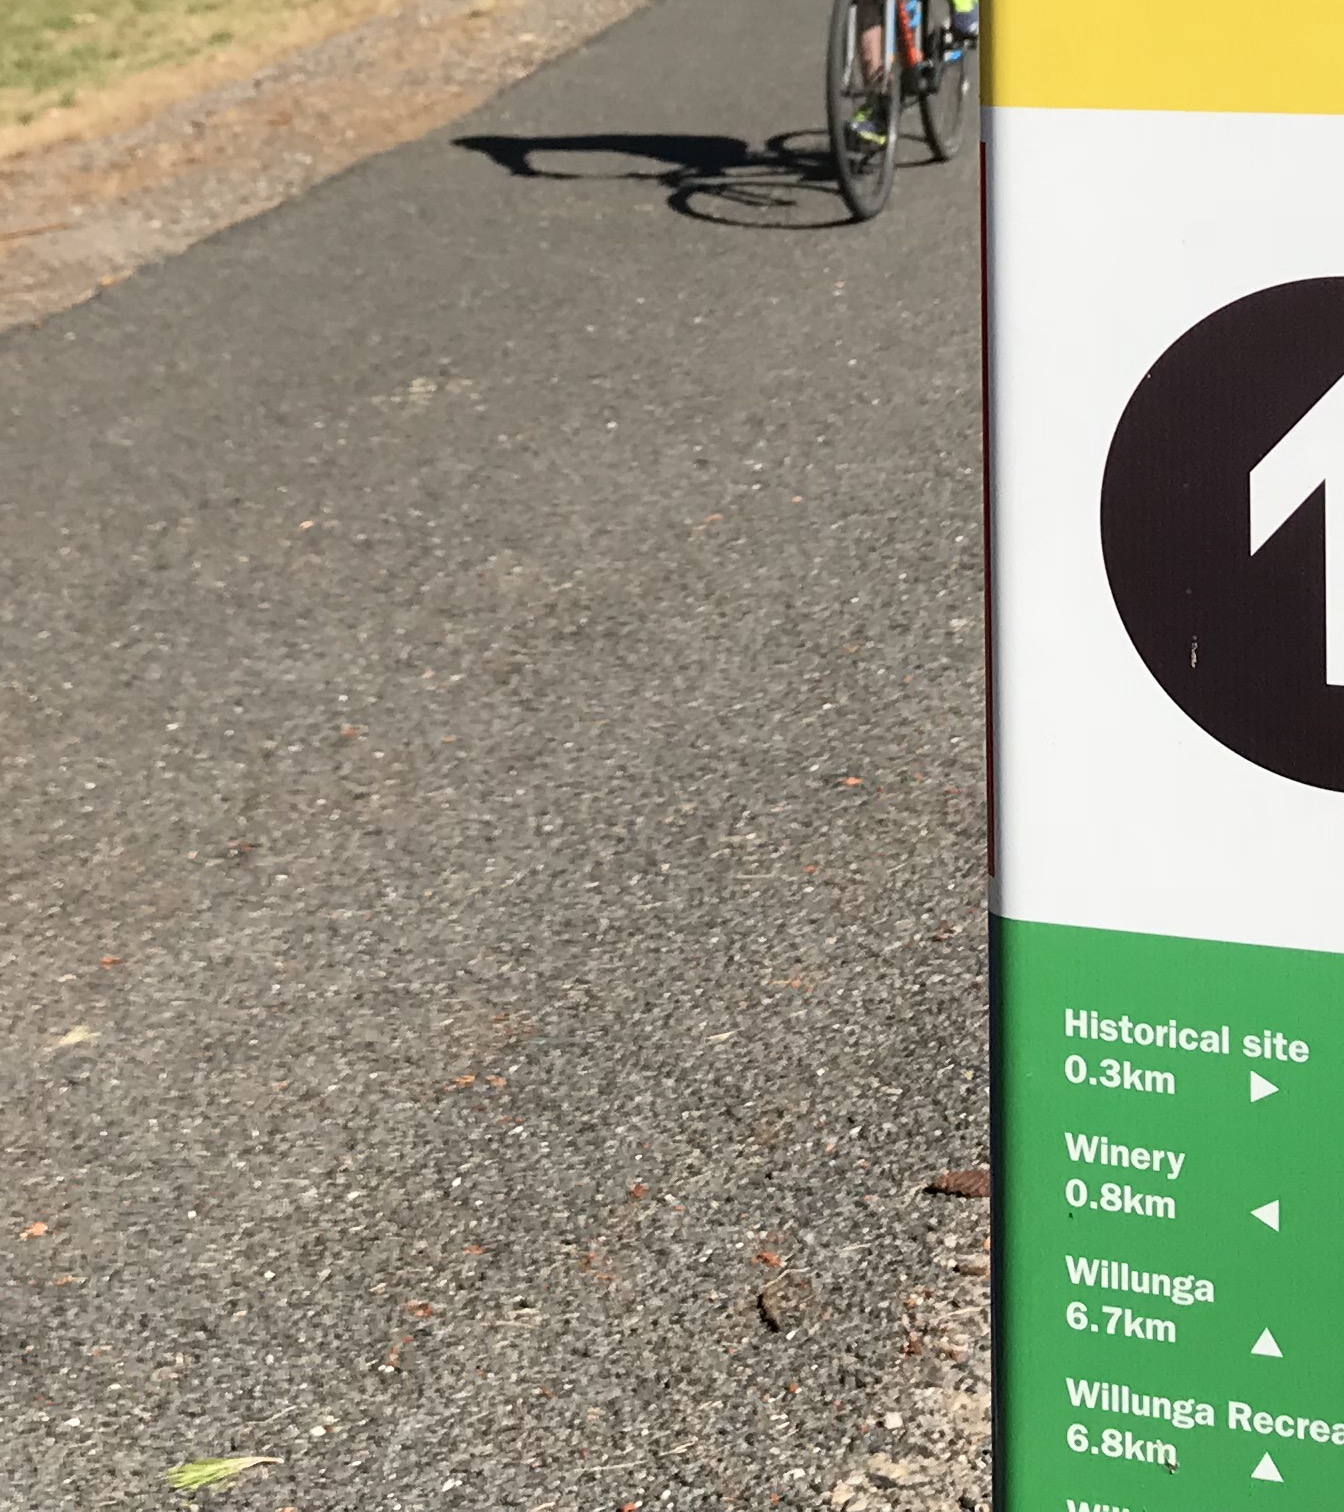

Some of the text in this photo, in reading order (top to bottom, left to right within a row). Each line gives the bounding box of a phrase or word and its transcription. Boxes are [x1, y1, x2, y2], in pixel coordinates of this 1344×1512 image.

[1065, 1008, 1310, 1063] Historical site
[1064, 1054, 1175, 1095] 0.3km
[1064, 1132, 1186, 1180] Winery
[1065, 1178, 1176, 1219] 0.8km
[1065, 1255, 1215, 1306] Willunga
[1066, 1301, 1176, 1343] 6.7km
[1065, 1377, 1215, 1429] Willunga
[1066, 1423, 1178, 1467] 6.8km
